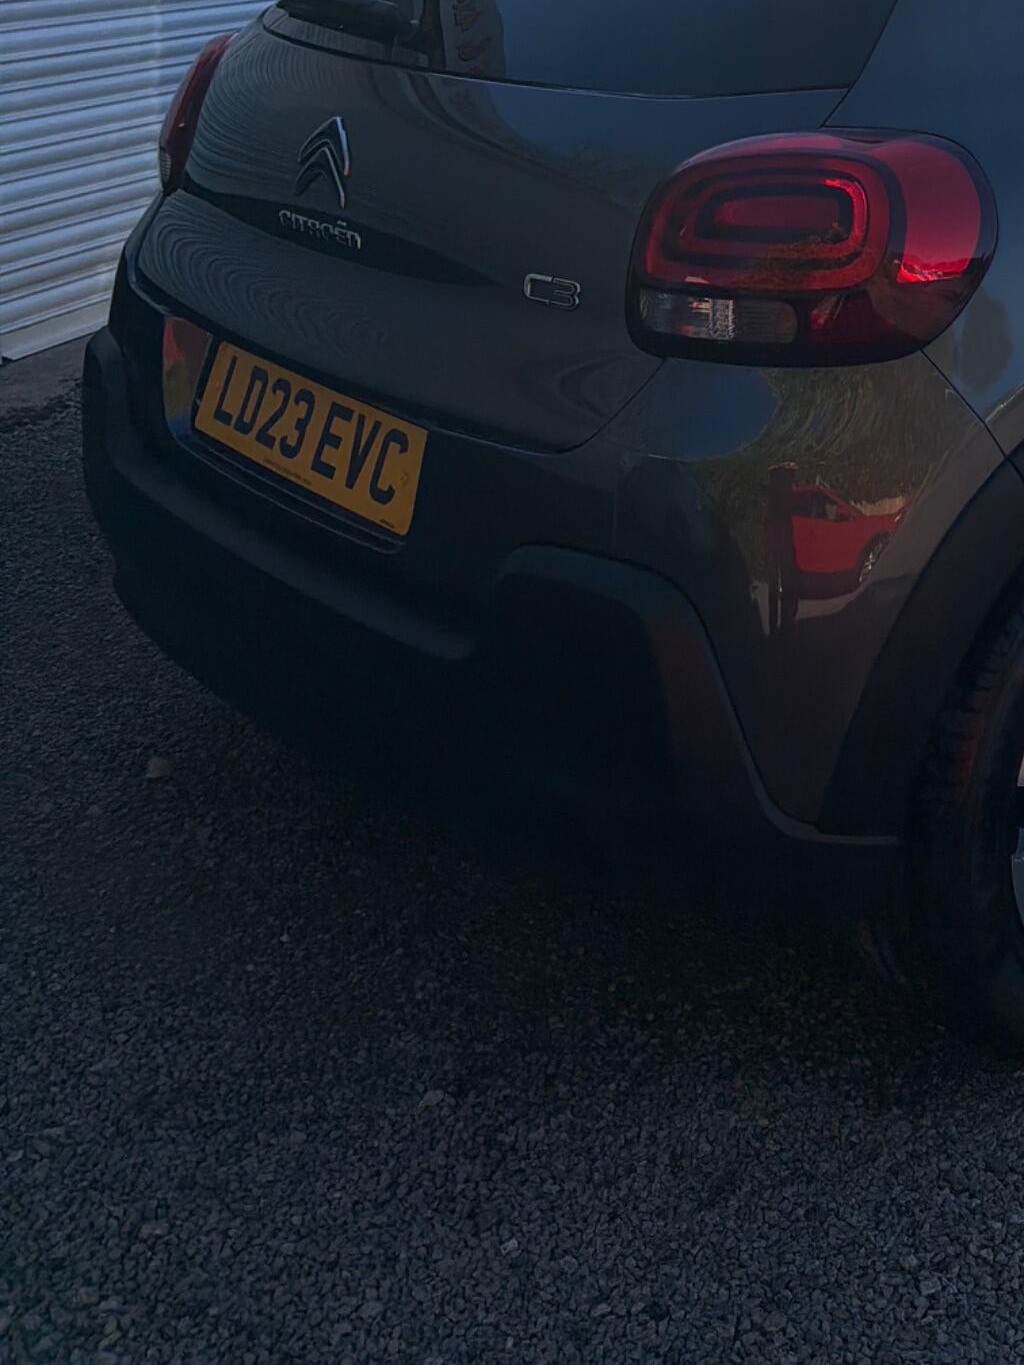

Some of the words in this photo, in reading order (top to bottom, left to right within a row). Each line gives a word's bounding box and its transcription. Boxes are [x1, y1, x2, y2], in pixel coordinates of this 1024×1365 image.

[523, 272, 582, 311] C3
[212, 354, 316, 460] LD23
[310, 400, 410, 507] EVC
